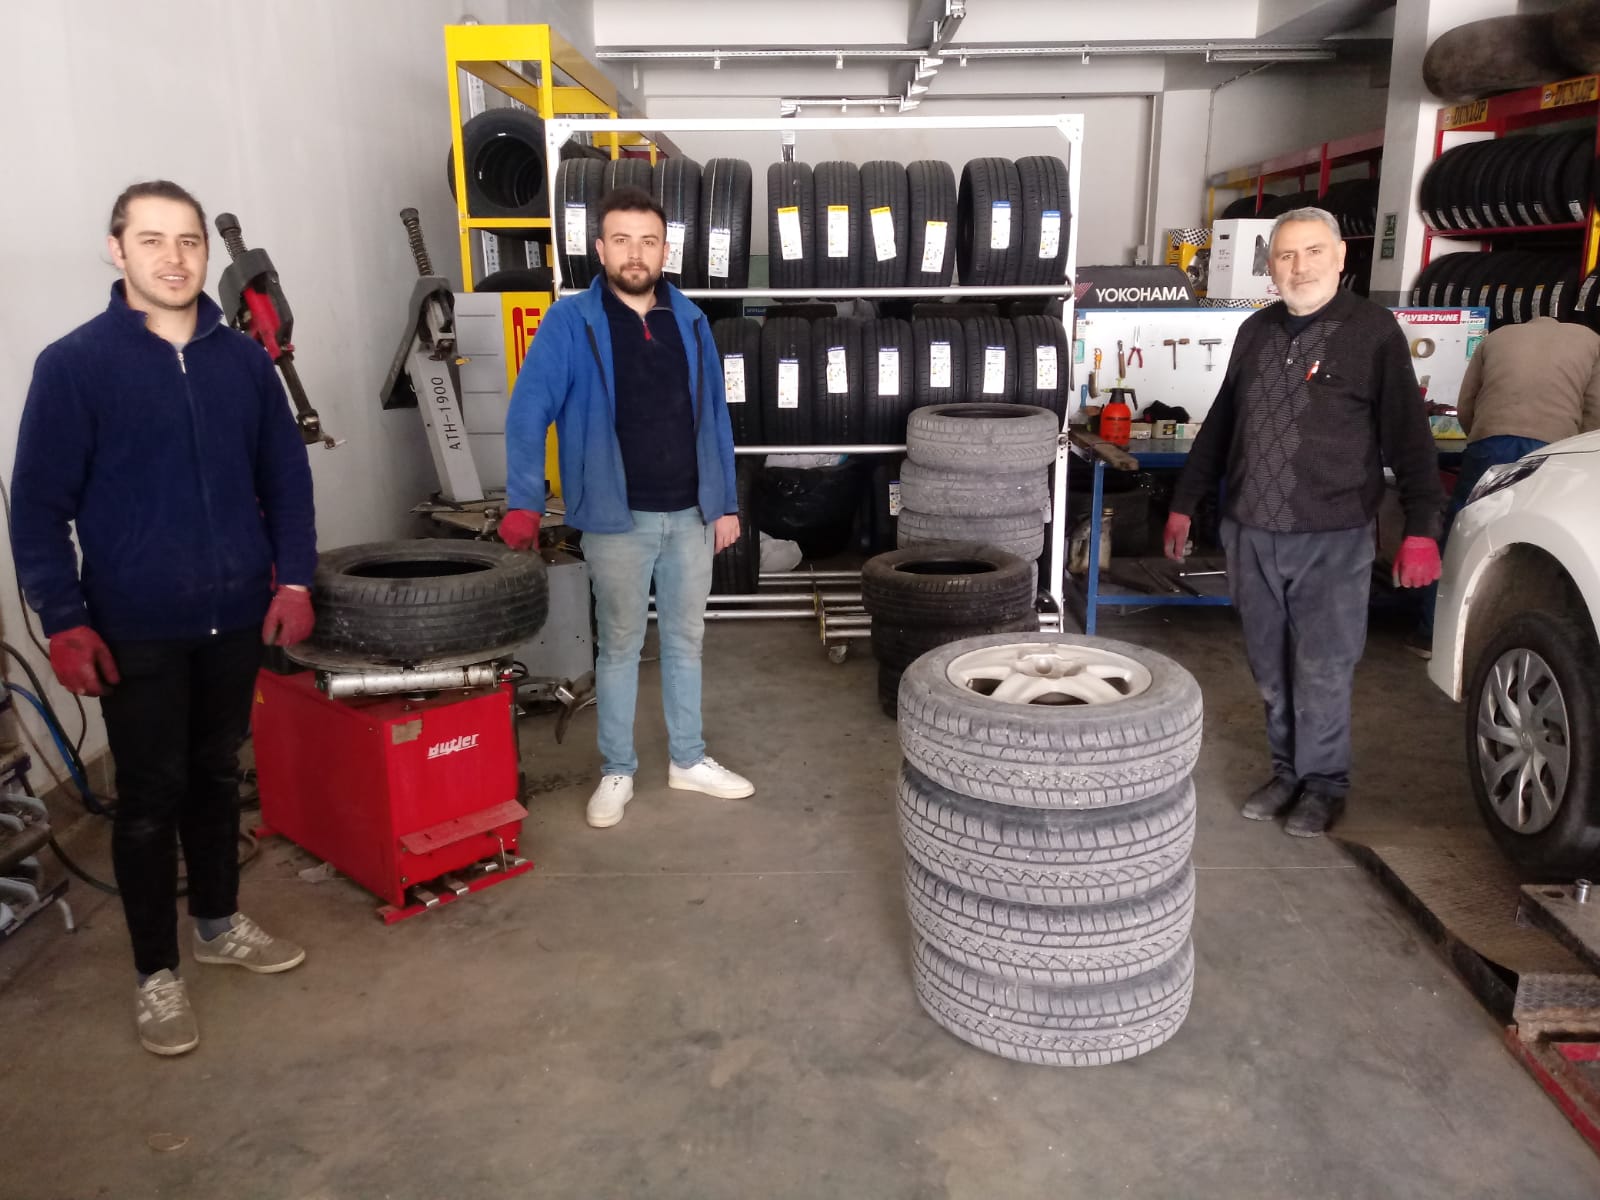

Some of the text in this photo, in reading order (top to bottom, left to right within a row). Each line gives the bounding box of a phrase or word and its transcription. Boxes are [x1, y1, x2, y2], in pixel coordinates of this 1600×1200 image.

[1554, 78, 1597, 105] DUNLOP
[1453, 101, 1487, 125] DUNLOP
[1096, 286, 1189, 303] YOKOHAMA
[1396, 312, 1459, 323] SILVERSTONE
[431, 377, 463, 451] ATH-1900
